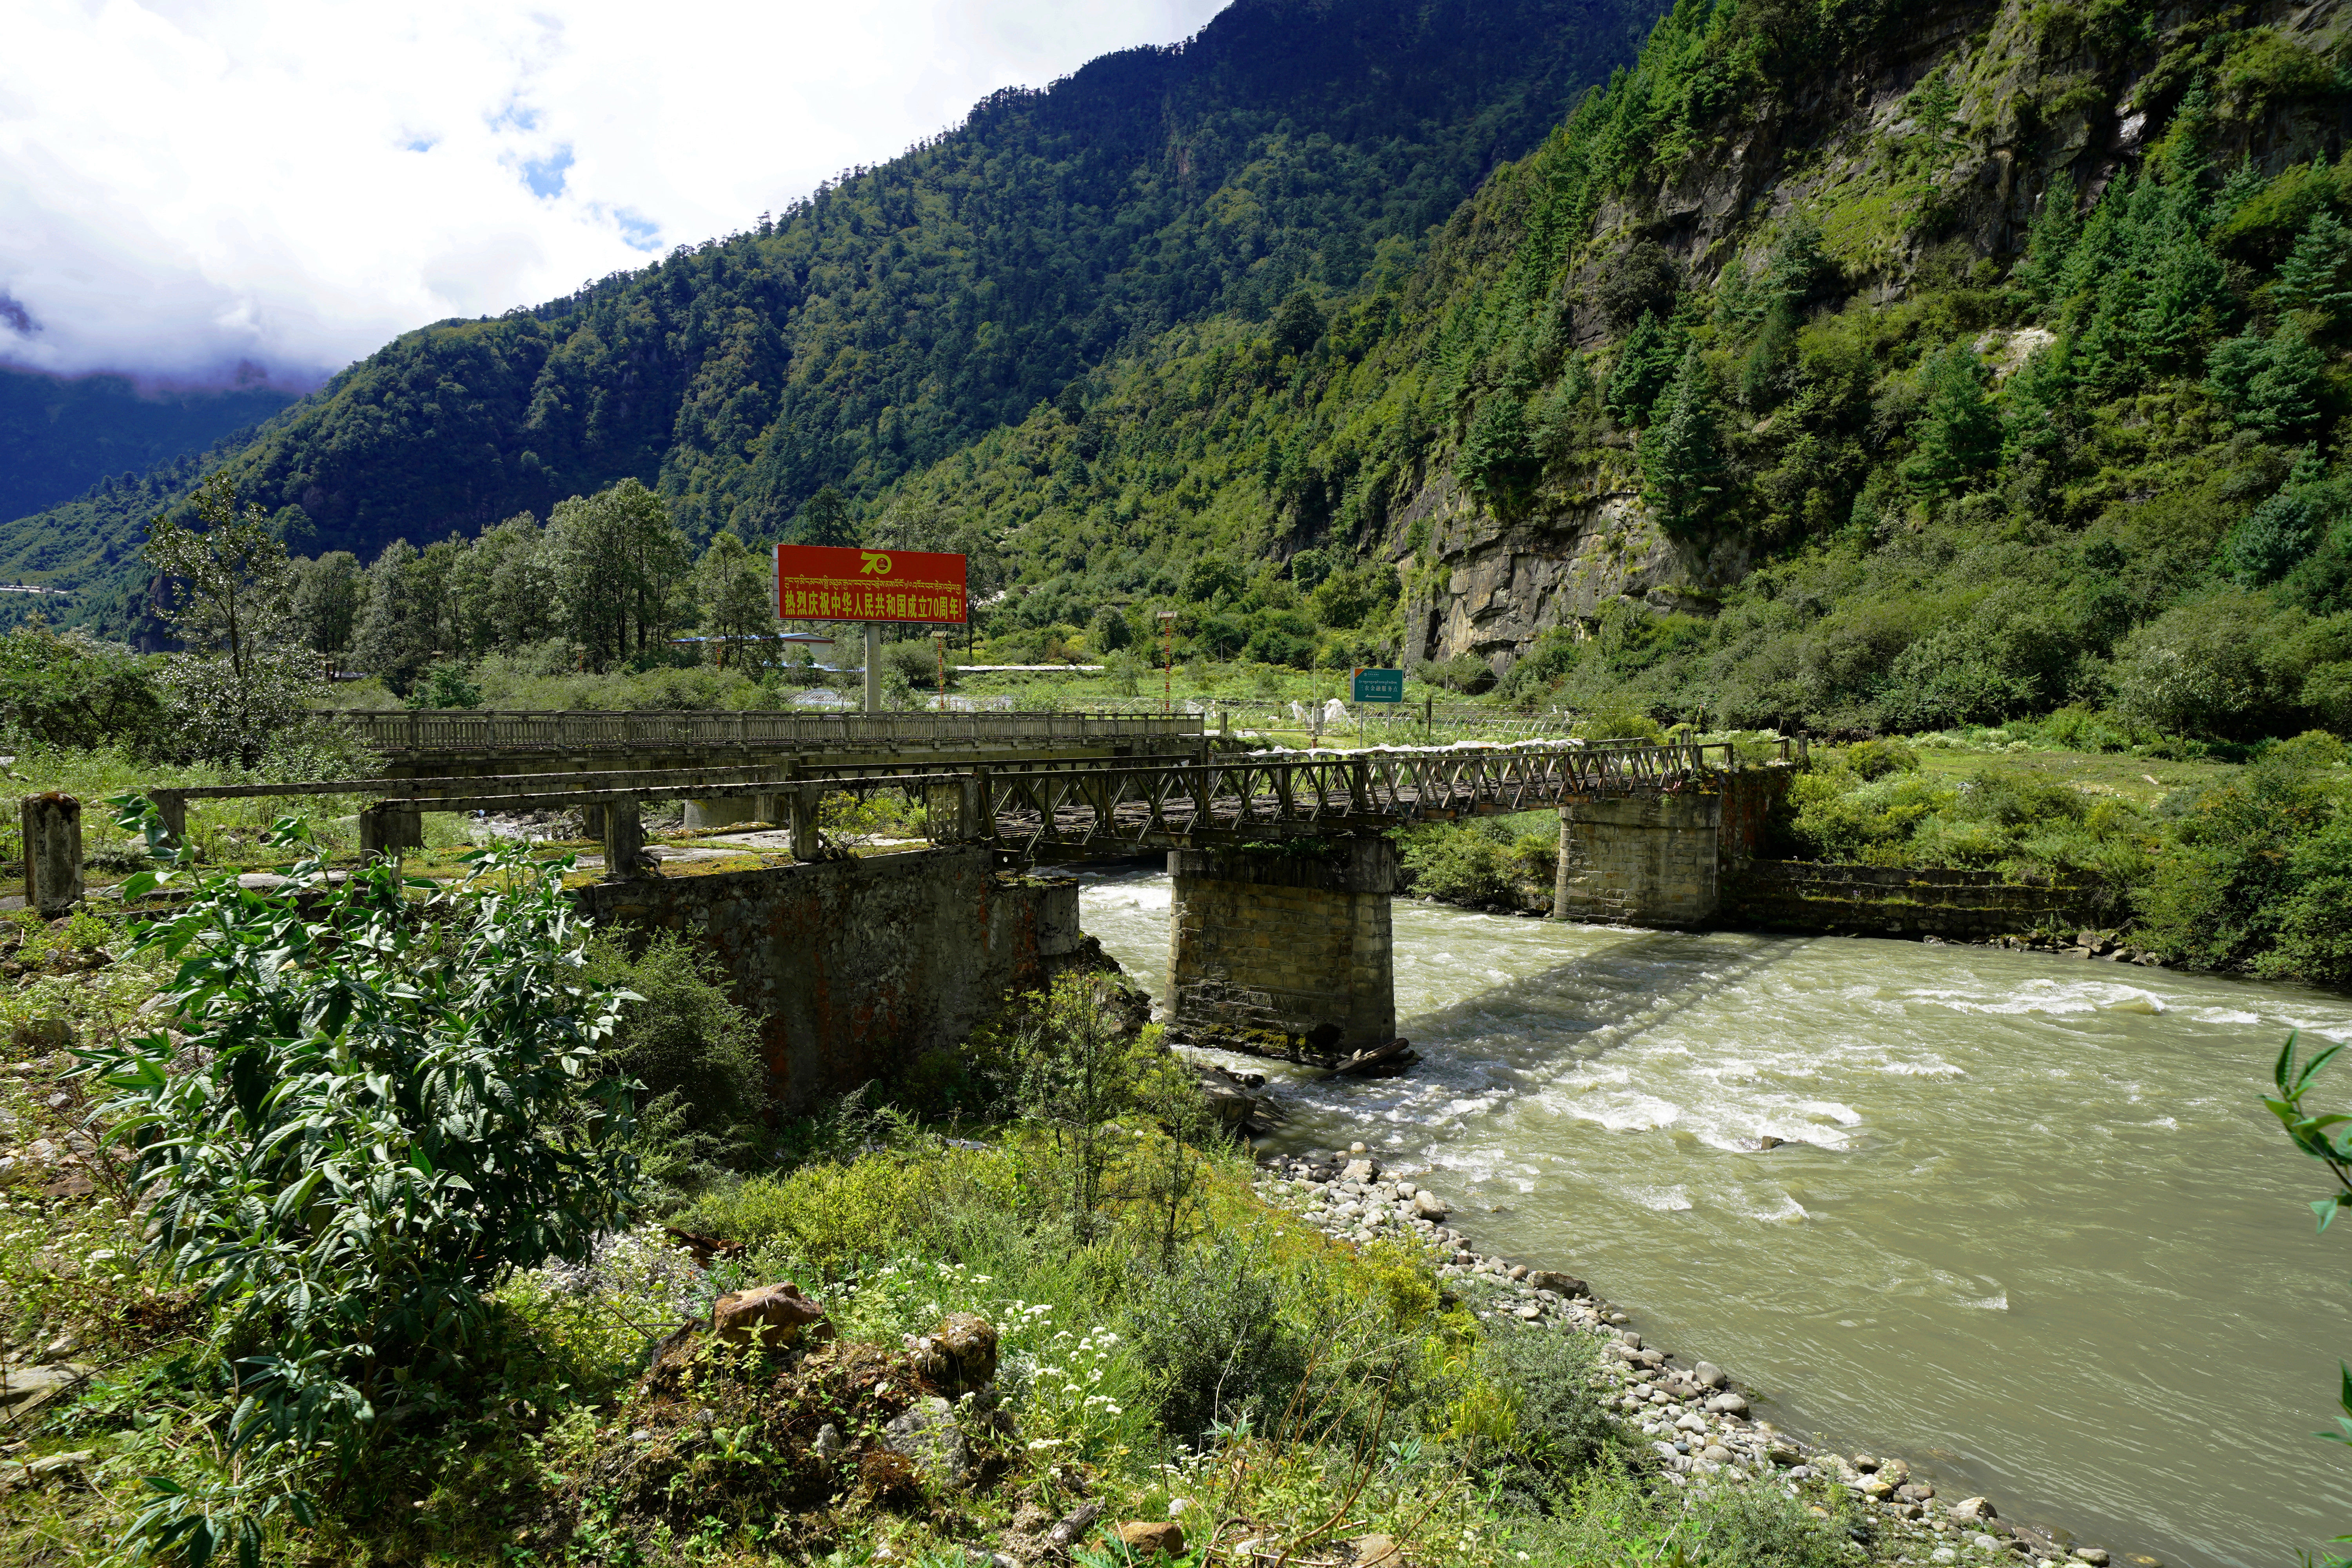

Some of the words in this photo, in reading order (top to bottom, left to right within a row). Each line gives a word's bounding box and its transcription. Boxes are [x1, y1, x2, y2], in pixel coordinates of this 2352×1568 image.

[860, 551, 892, 575] 70
[785, 590, 962, 620] 热烈庆祝中华人民共和国成立70周年!
